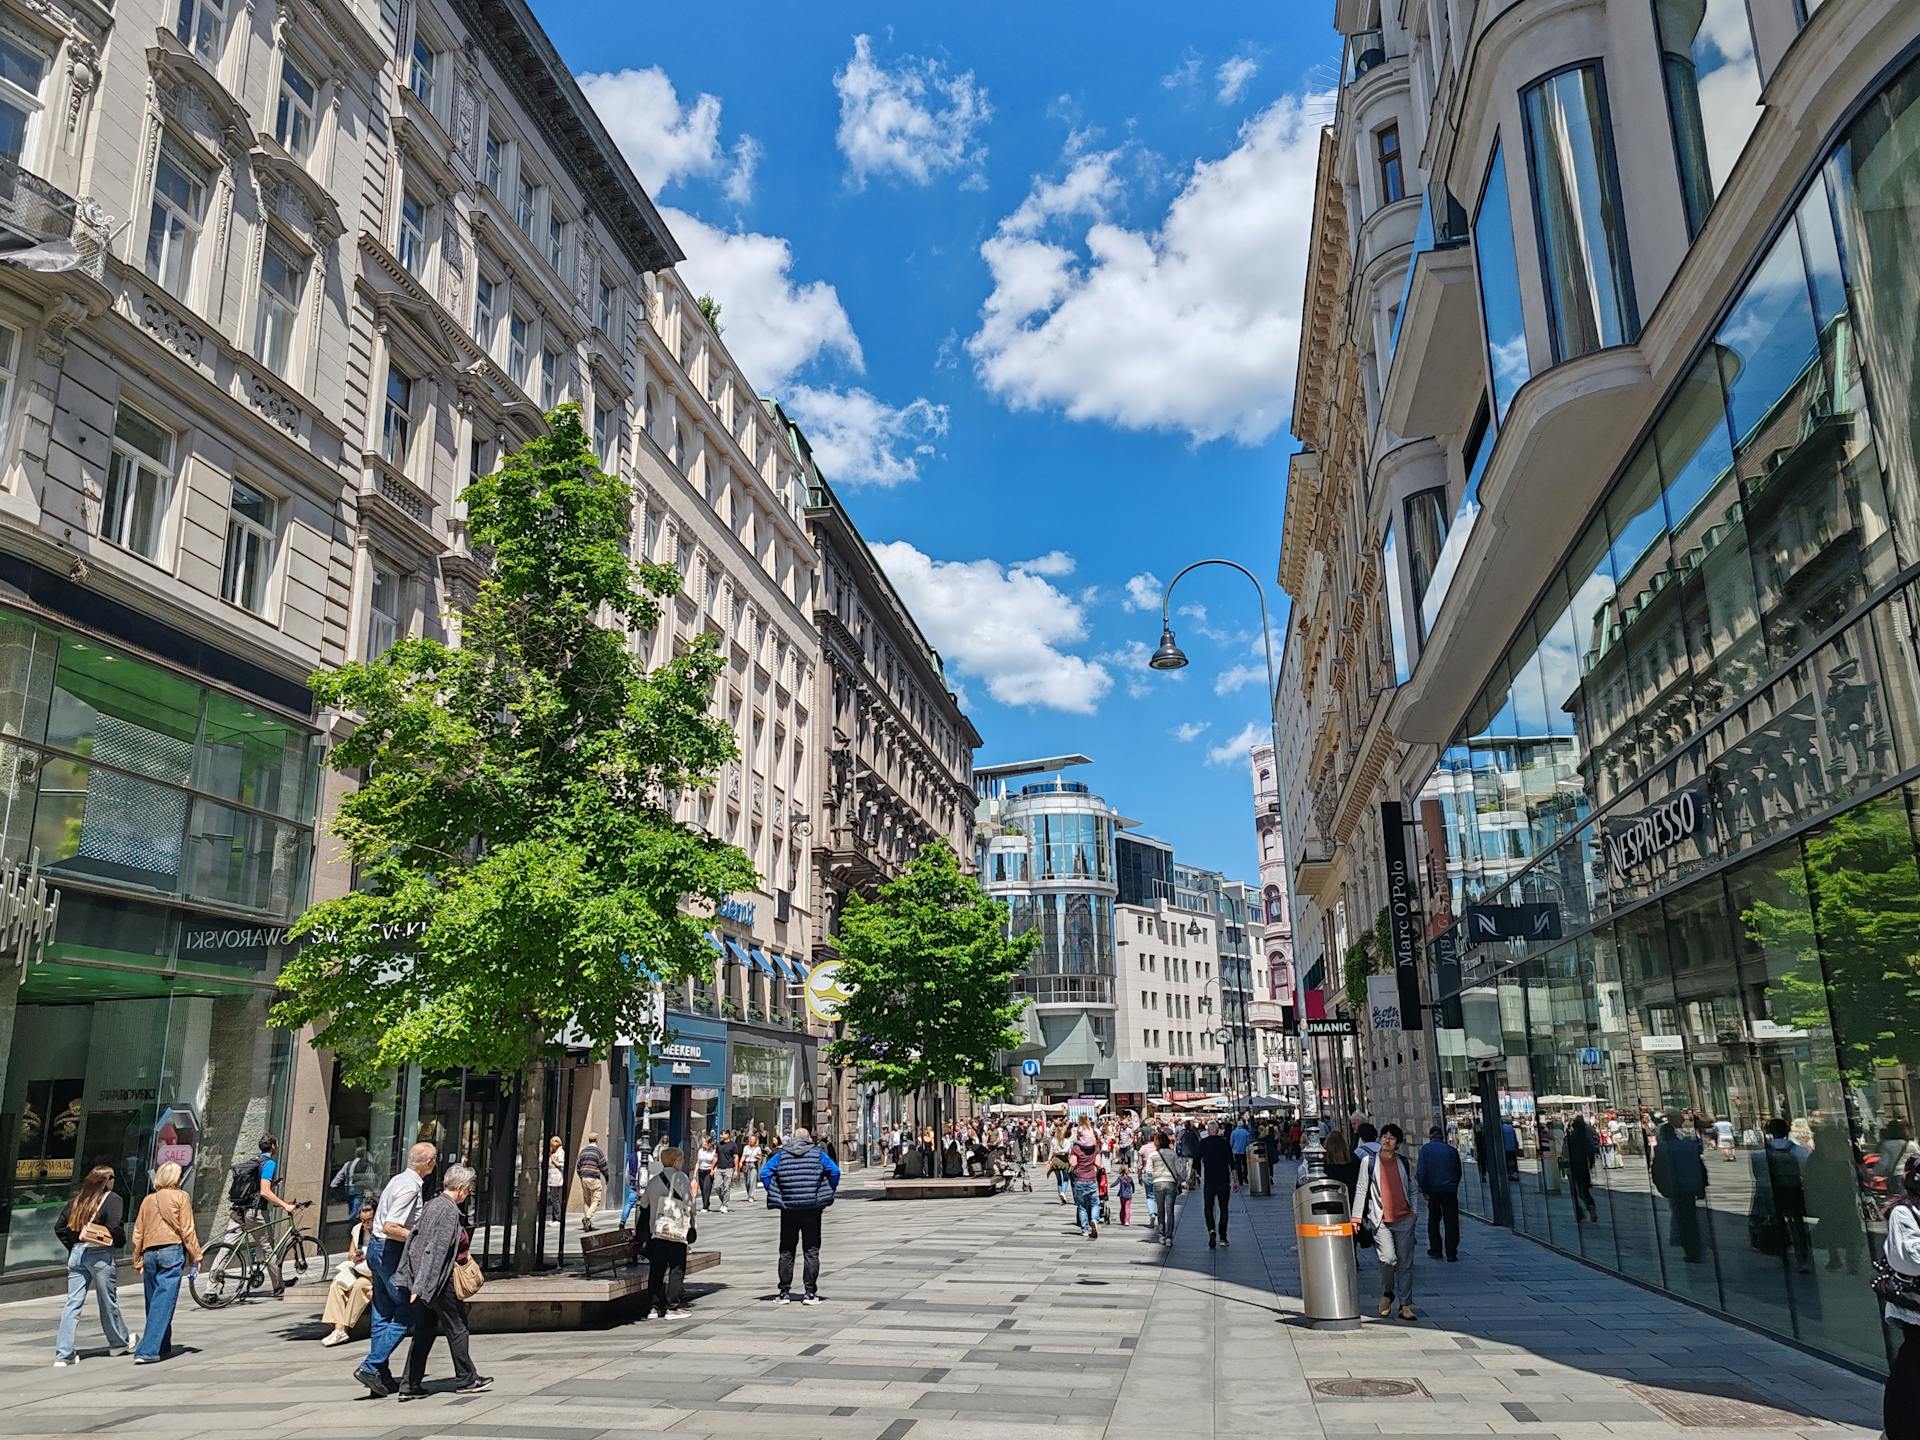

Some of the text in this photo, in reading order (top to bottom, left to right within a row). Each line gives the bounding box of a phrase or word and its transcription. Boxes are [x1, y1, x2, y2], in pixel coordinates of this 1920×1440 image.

[1606, 792, 1695, 879] NESPRESSO
[1391, 860, 1413, 967] Marc O'Polo
[1298, 1022, 1351, 1033] UMANIC
[662, 1044, 702, 1058] WEEKEND
[164, 1151, 186, 1161] SALE
